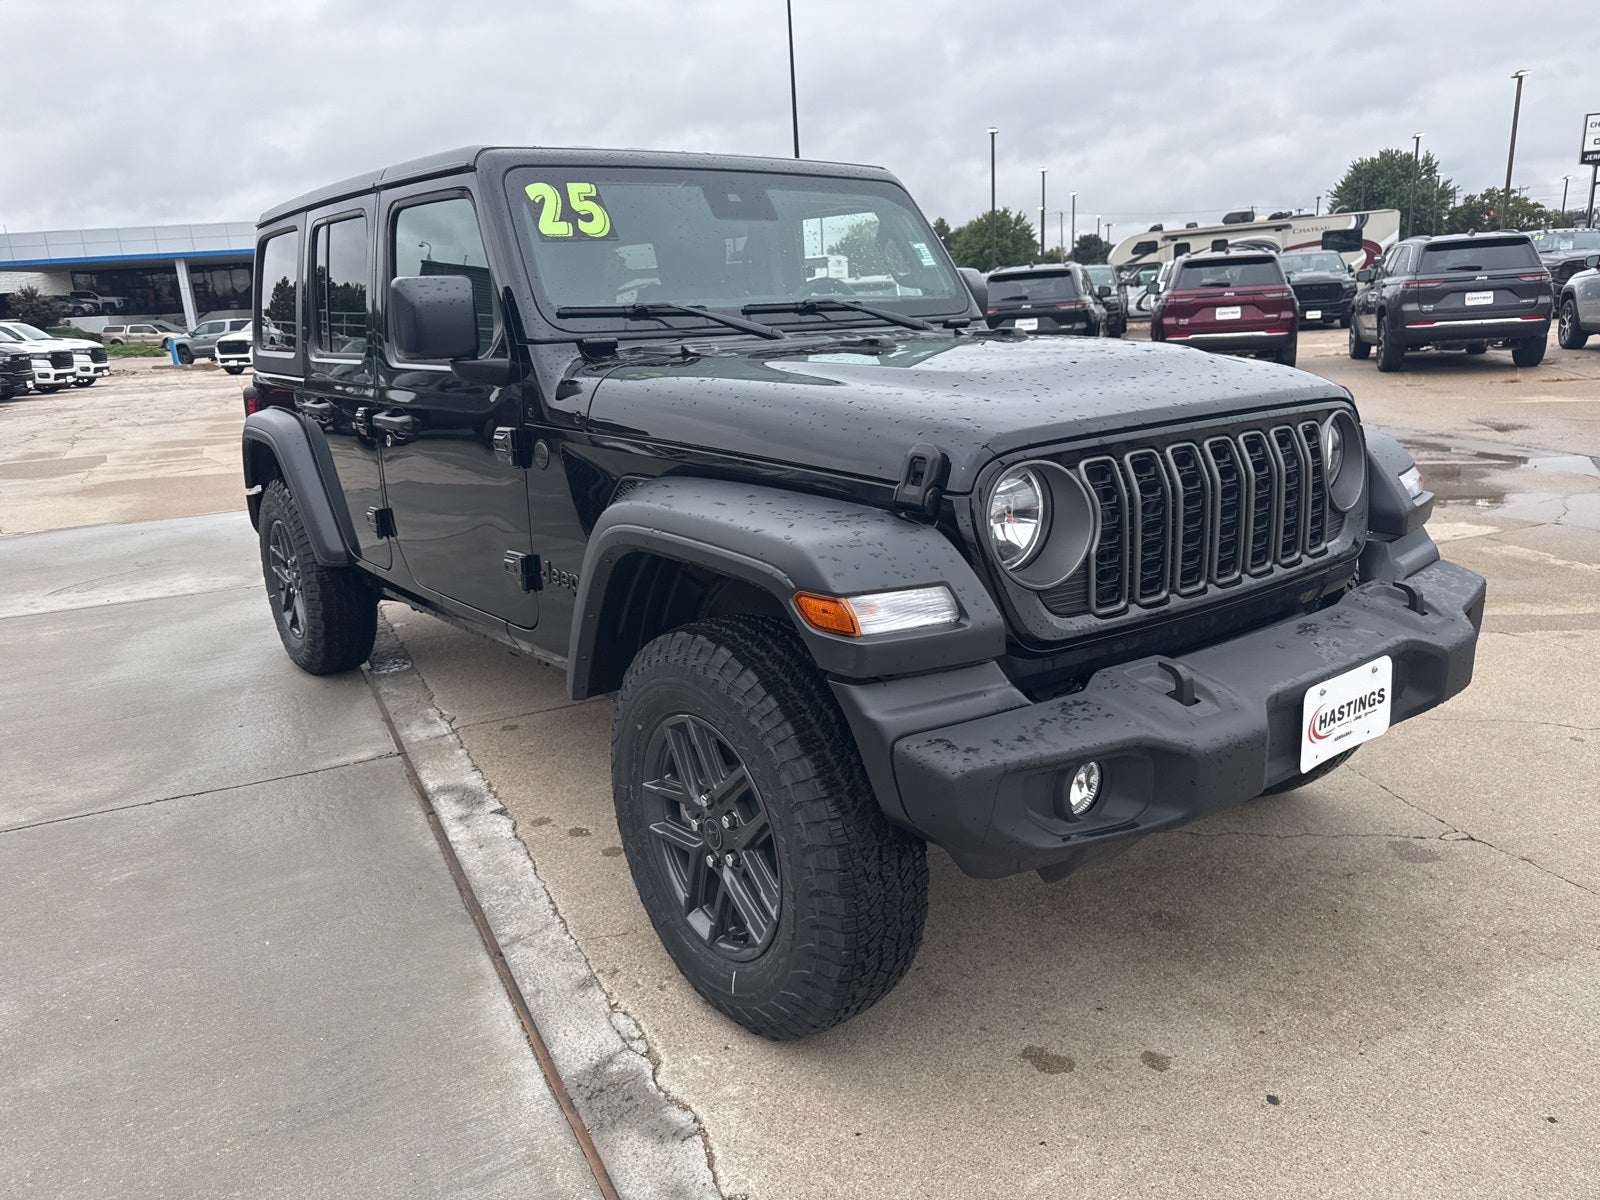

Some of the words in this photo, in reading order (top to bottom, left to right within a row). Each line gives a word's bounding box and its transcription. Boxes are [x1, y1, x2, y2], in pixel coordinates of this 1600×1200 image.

[524, 182, 611, 239] 25
[1292, 226, 1330, 235] CHATEAU
[1318, 687, 1386, 731] HASTINGS
